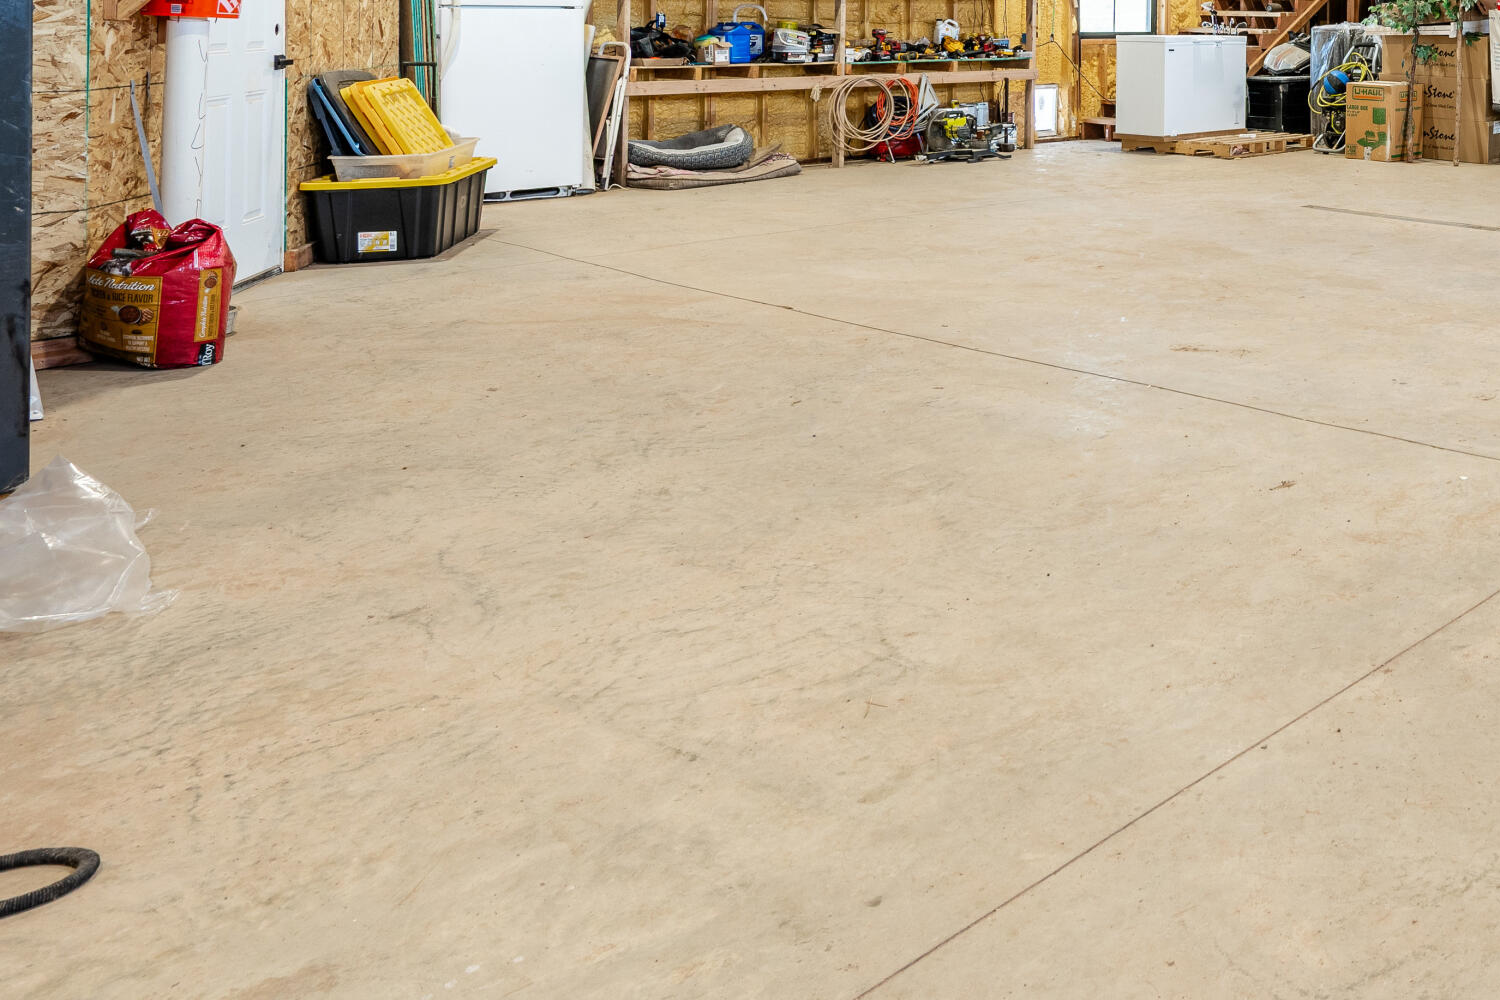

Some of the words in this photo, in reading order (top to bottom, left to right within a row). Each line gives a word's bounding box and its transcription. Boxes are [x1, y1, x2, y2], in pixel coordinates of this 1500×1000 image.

[1354, 87, 1383, 96] U-HAUL
[103, 277, 156, 291] Nutrition
[127, 292, 154, 304] FLAVOR
